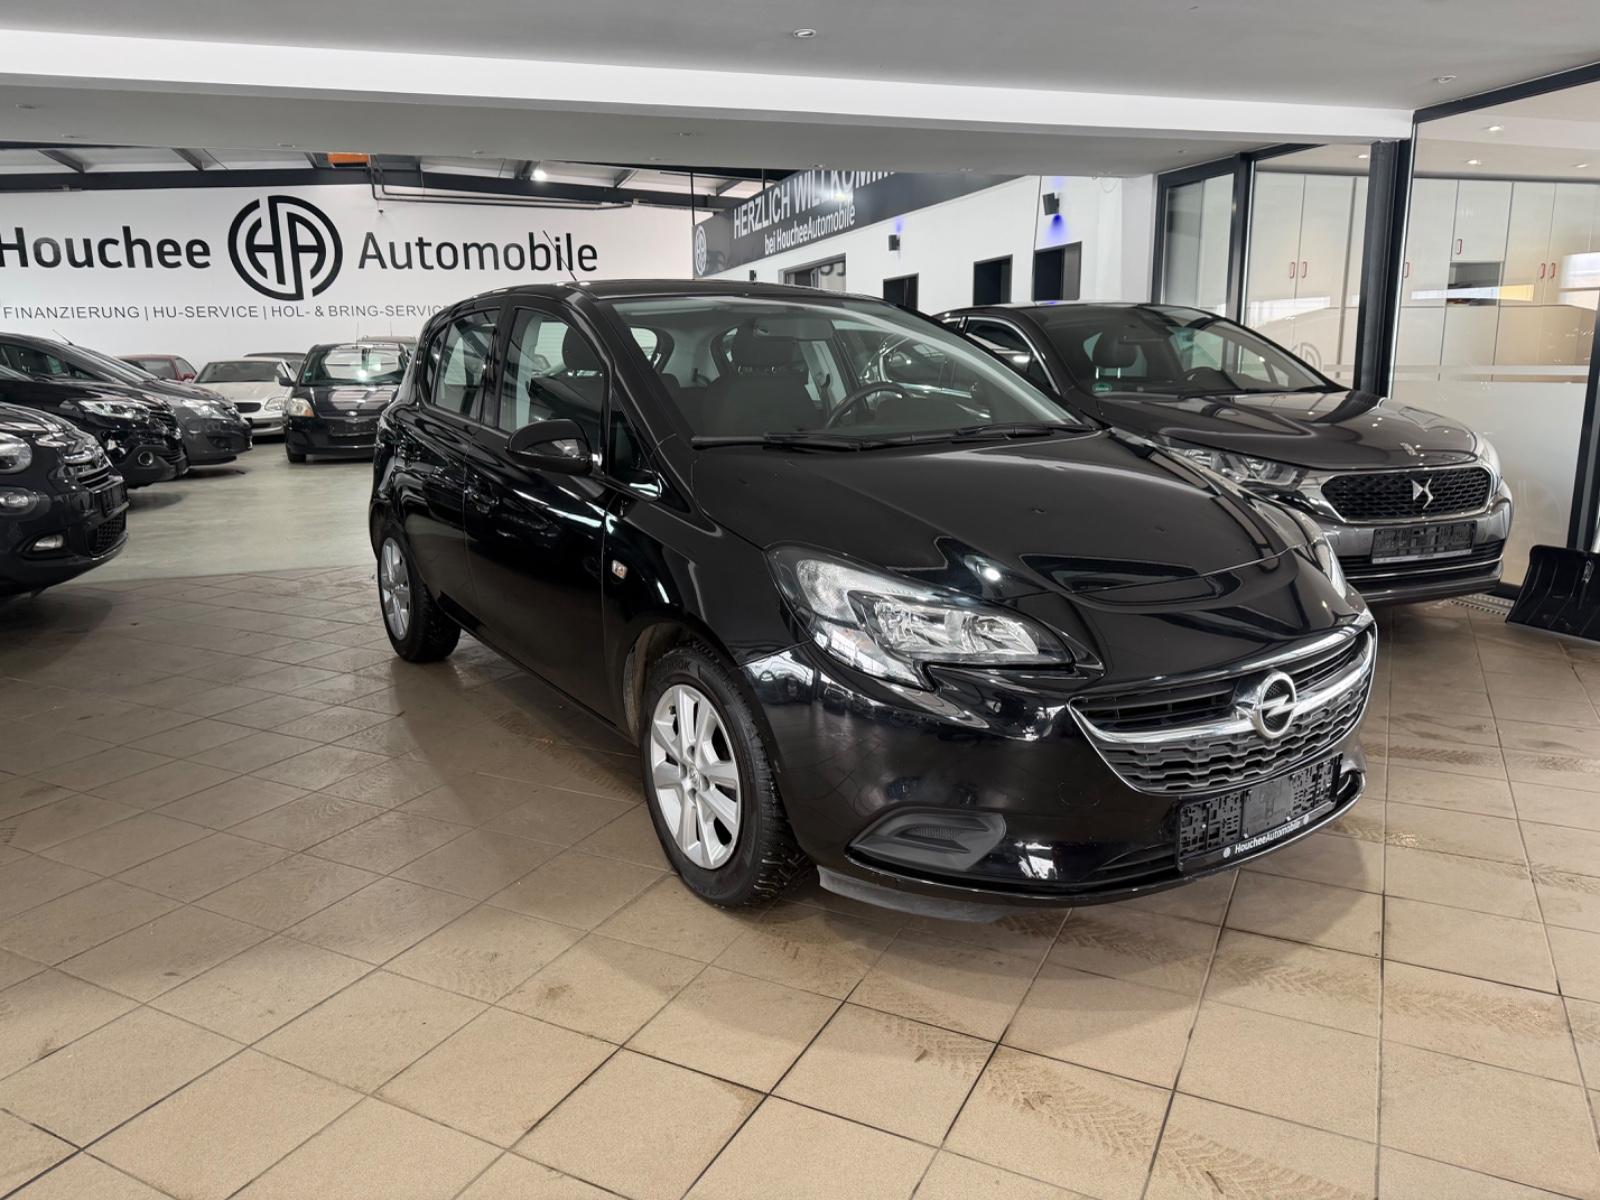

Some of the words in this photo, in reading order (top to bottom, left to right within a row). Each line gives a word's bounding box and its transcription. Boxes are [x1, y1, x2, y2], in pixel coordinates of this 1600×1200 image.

[733, 180, 791, 240] HERZLICH
[793, 171, 895, 214] WILLKO
[764, 230, 777, 256] bei
[776, 204, 856, 252] HoucheeAutomobile
[0, 226, 211, 269] Houchee
[357, 231, 598, 272] Automobile
[3, 306, 140, 319] FINANZIERUNG
[153, 305, 259, 319] HU-SERVICE
[271, 304, 311, 318] HOL-
[314, 304, 325, 317] &
[328, 304, 448, 318] BRING-SERVIC
